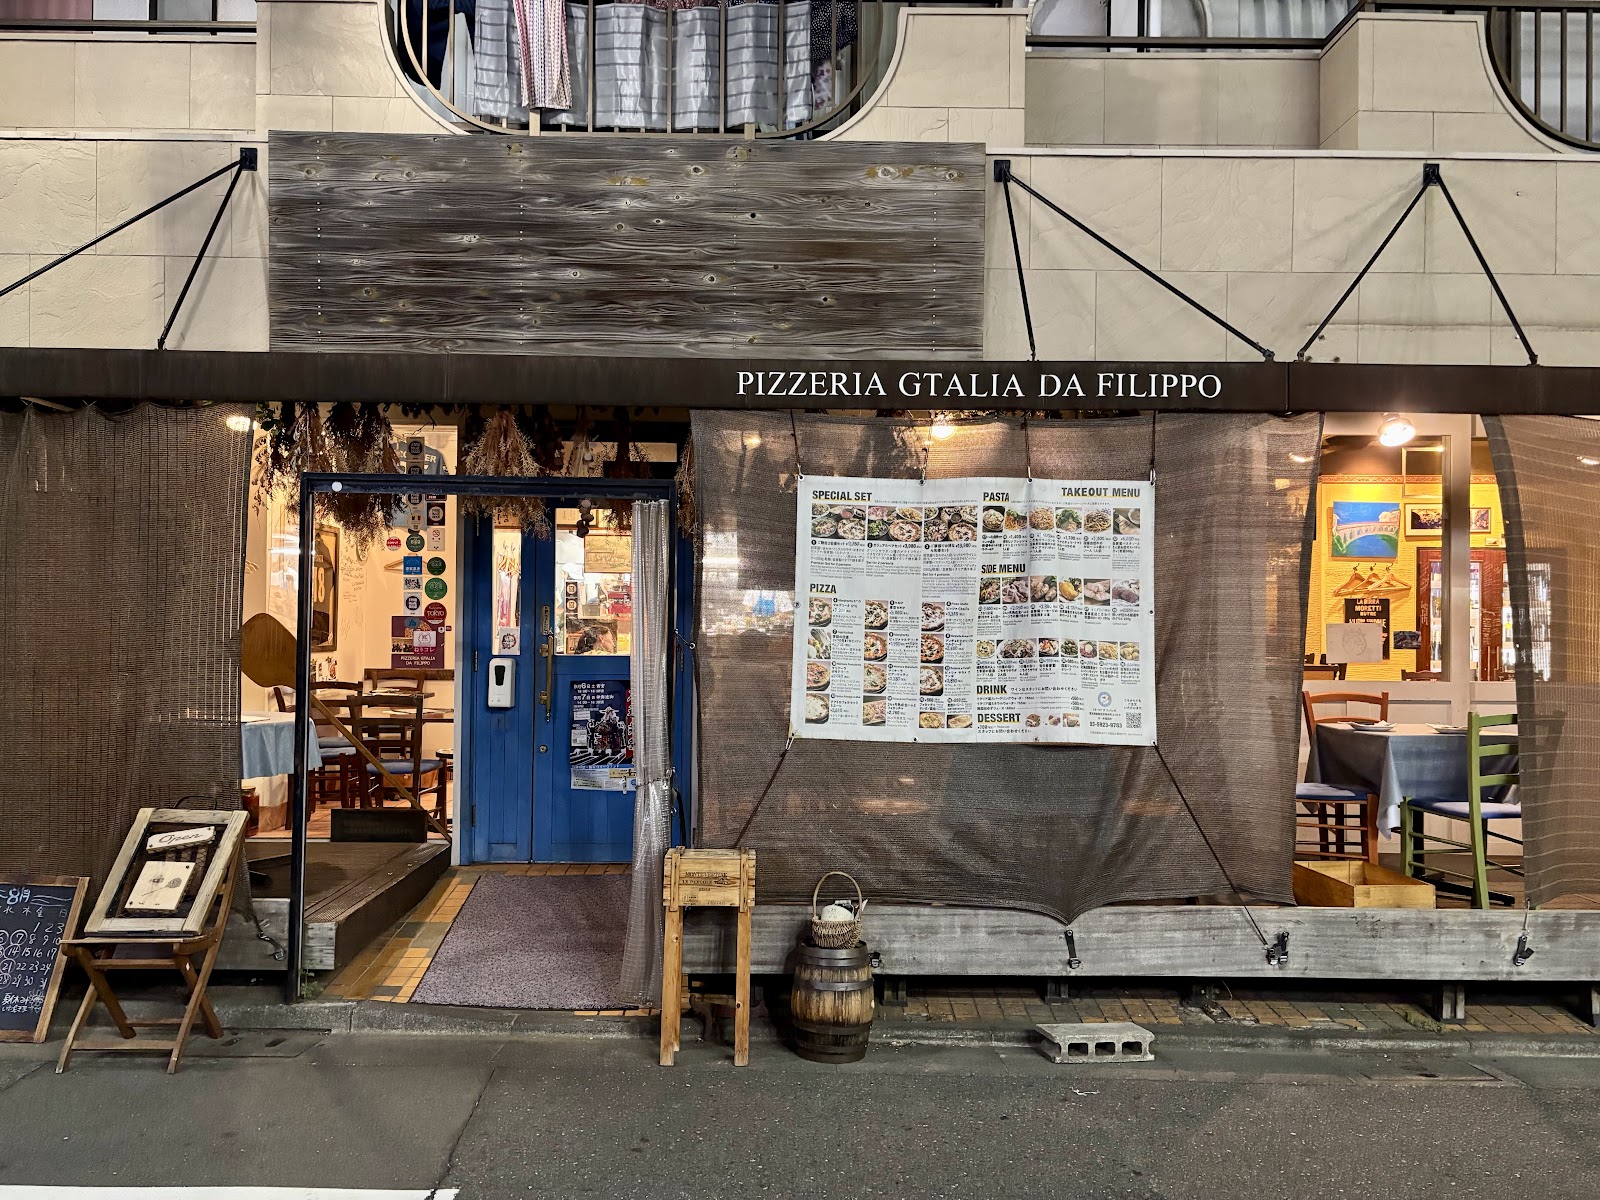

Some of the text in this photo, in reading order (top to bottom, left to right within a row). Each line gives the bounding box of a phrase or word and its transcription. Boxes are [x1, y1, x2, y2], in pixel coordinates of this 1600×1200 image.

[736, 371, 1222, 399] PIZZERIA GTALIA DA FILIPPO
[812, 490, 873, 501] SPECIAL SET
[983, 492, 1010, 502] PASTA
[1061, 487, 1141, 498] TAKEOUT MENU
[981, 563, 1026, 574] SIDE MENU
[809, 583, 837, 594] PIZZA
[977, 685, 1008, 695] DRINK
[977, 713, 1021, 723] DESSERT
[158, 833, 204, 845] Open
[6, 886, 31, 905] 8月
[3, 905, 15, 915] 水
[33, 922, 65, 934] 1 2 3
[16, 933, 24, 943] 7
[29, 933, 36, 945] 8
[42, 934, 49, 946] 9
[8, 946, 58, 960] 14 15 16 17
[2, 960, 52, 975] 21 22 23 24
[12, 974, 22, 987] 29
[24, 975, 34, 986] 30
[39, 977, 48, 990] 31
